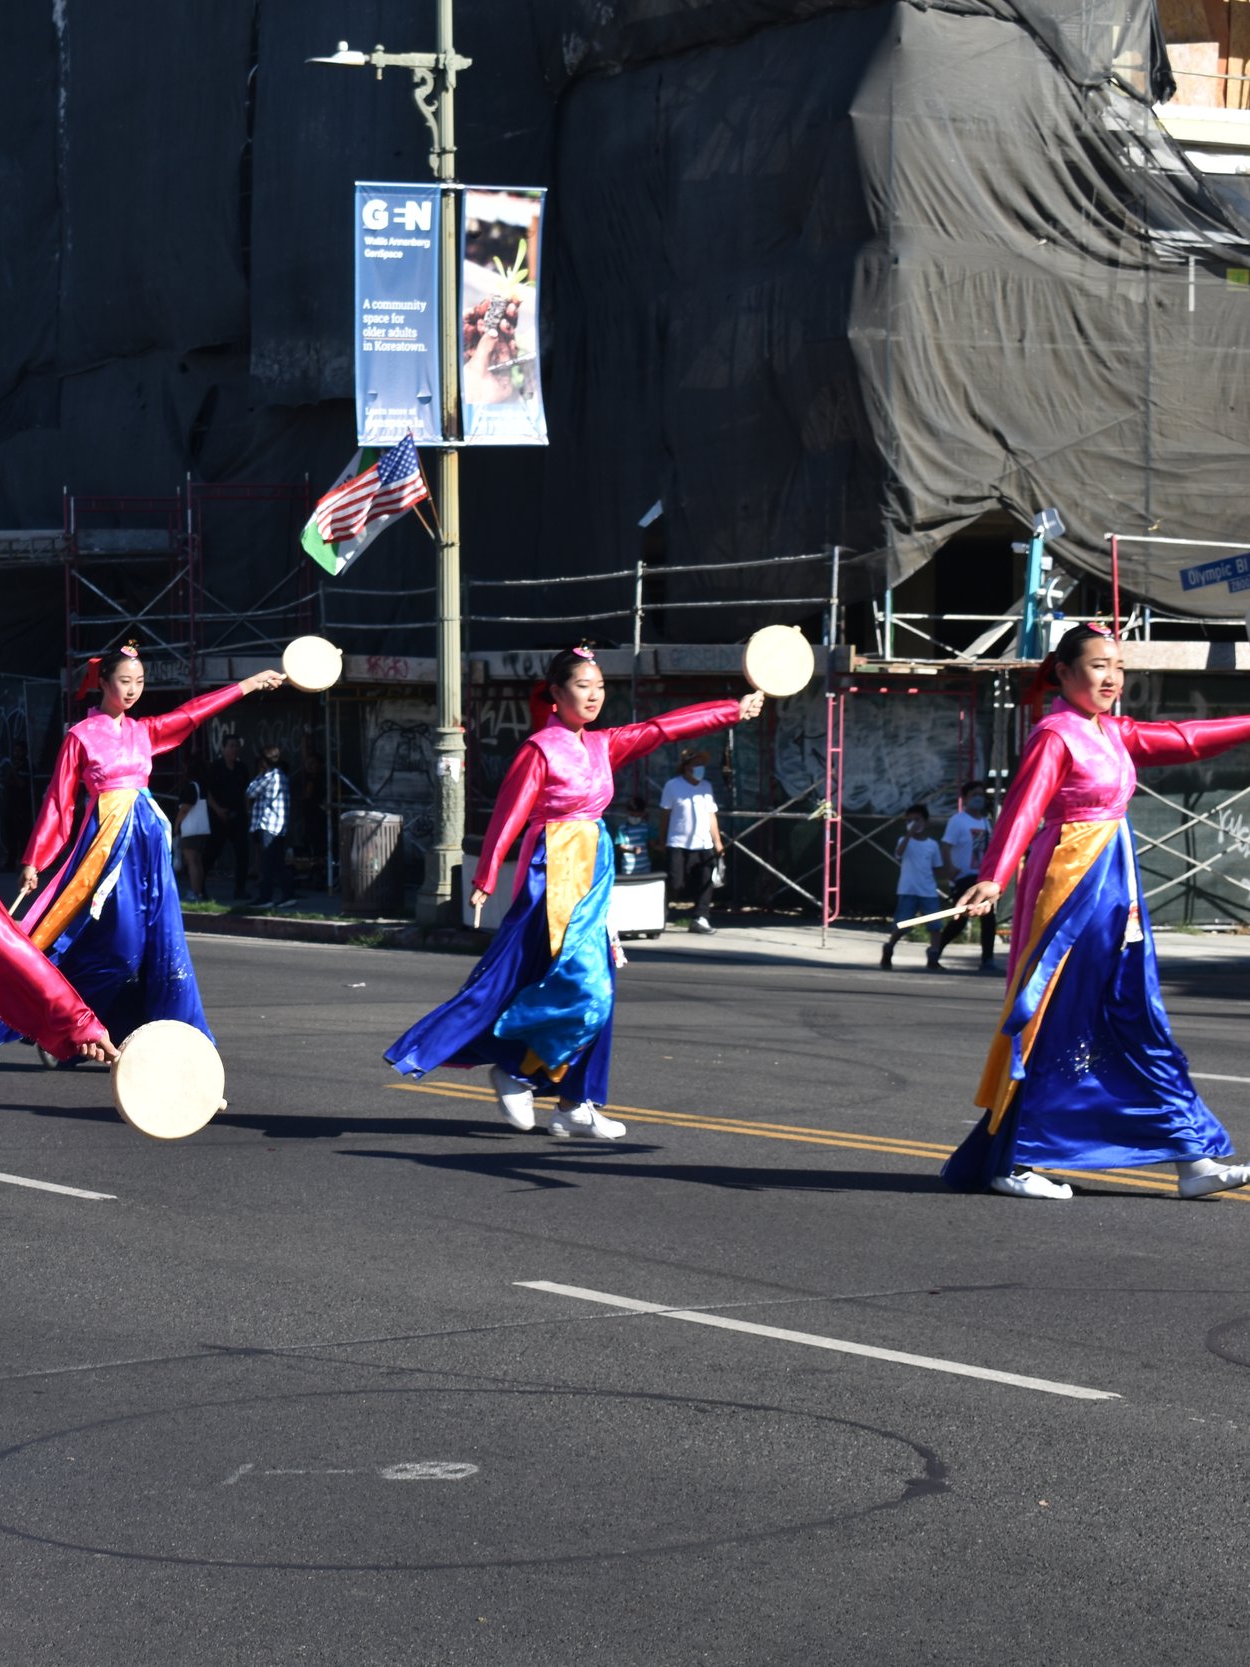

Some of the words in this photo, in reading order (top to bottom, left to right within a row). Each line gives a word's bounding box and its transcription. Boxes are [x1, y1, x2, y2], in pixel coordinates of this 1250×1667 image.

[363, 298, 371, 310] A
[372, 299, 427, 313] community
[362, 313, 390, 326] space
[391, 312, 405, 324] for
[362, 326, 387, 337] older
[388, 326, 418, 338] adults
[363, 340, 373, 351] in
[1188, 563, 1232, 586] Olympic
